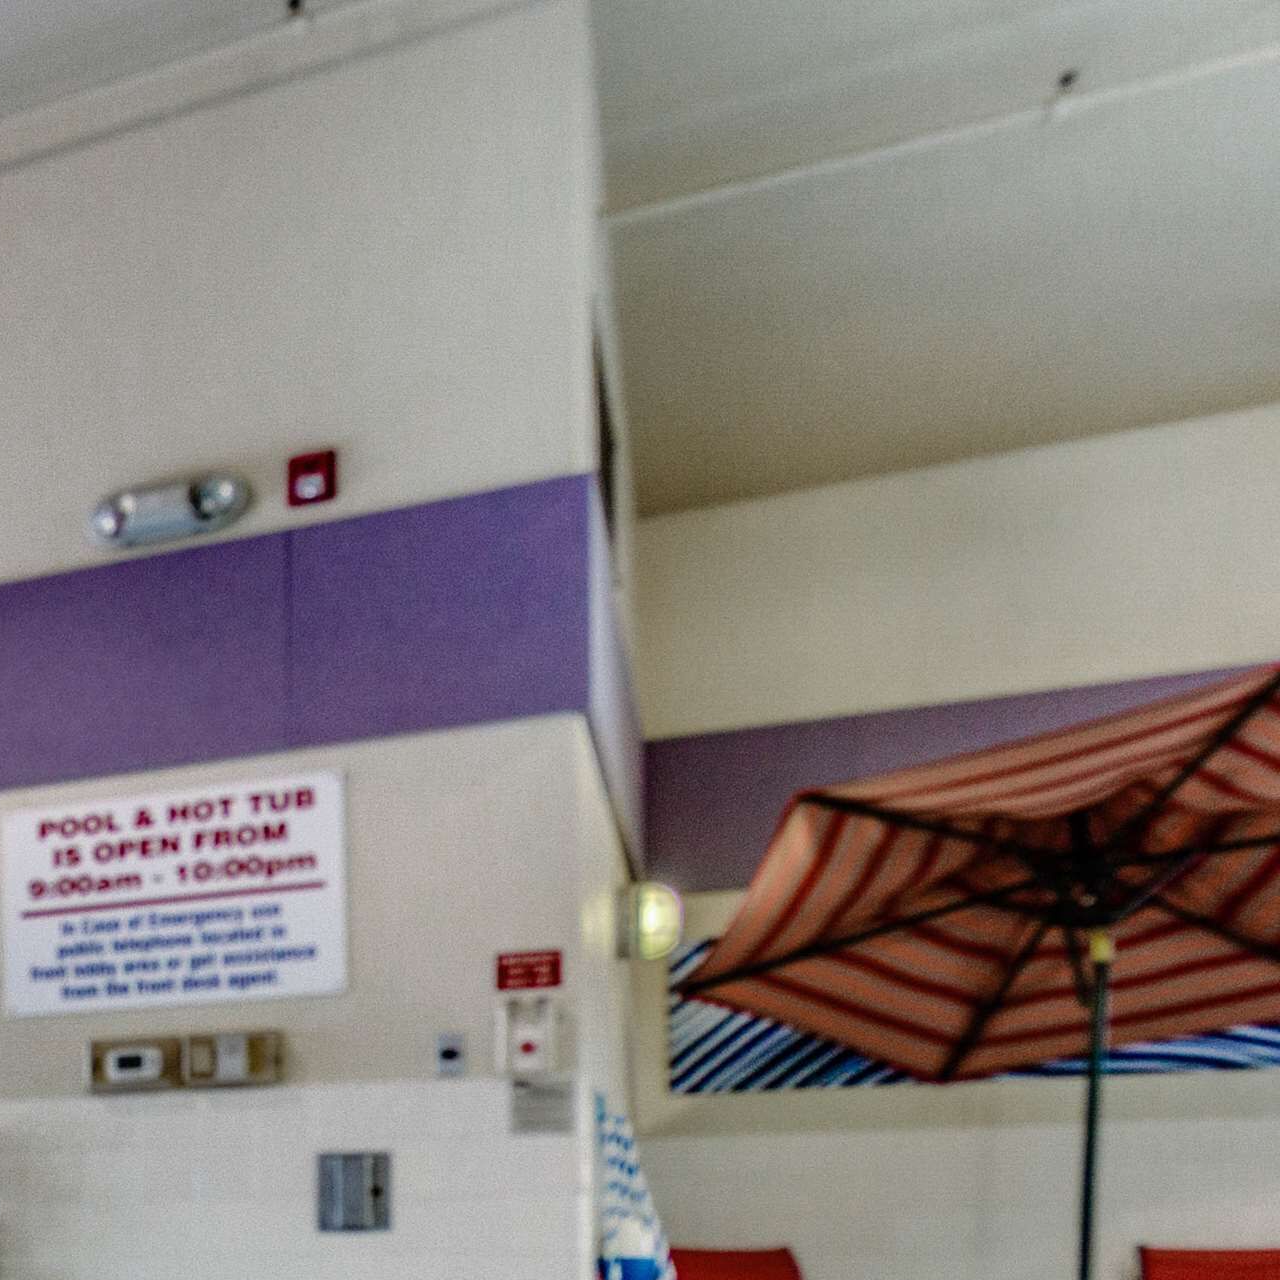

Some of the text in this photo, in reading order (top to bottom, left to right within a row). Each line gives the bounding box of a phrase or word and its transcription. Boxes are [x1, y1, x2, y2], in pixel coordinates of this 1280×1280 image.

[38, 787, 316, 839] POOL & HOT TUB
[53, 822, 287, 867] IS OPEN FROM
[30, 873, 141, 897] 9:00am
[177, 854, 316, 881] 10:00pm
